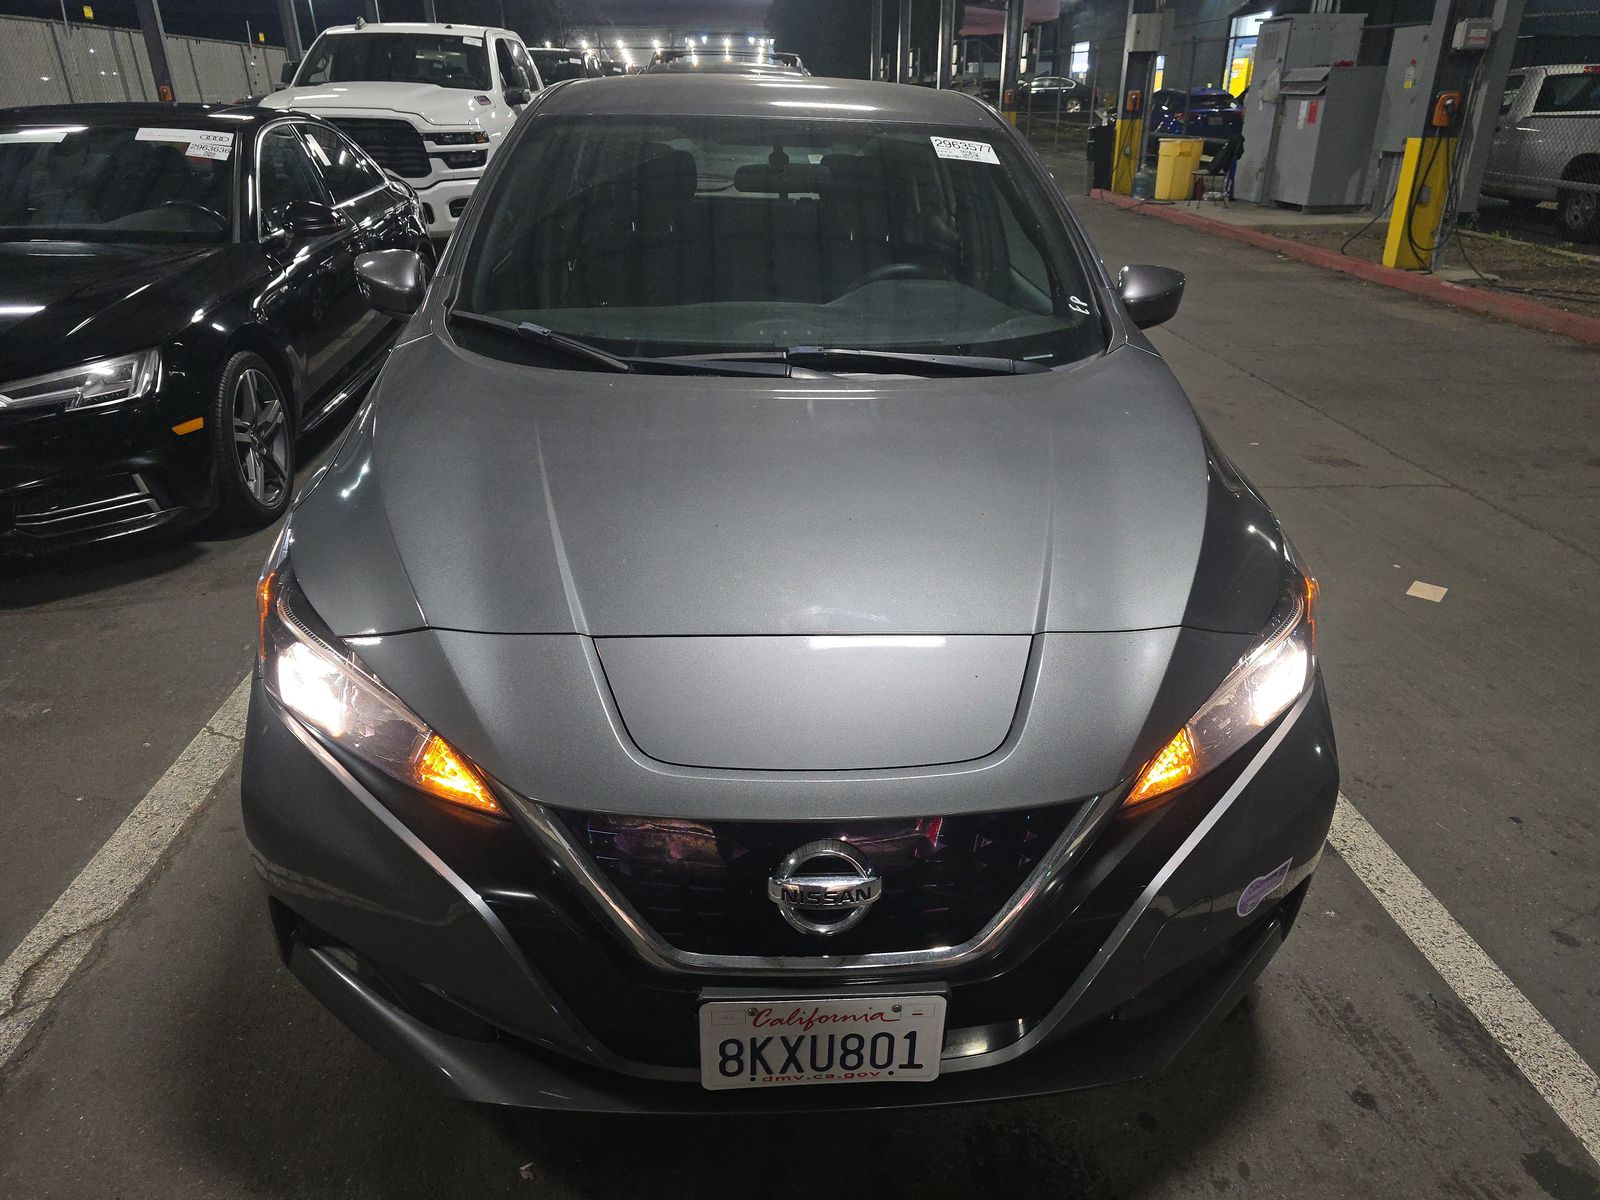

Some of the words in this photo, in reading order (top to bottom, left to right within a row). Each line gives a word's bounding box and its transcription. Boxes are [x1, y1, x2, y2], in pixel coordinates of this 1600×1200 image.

[934, 139, 991, 152] 2963577
[780, 887, 872, 903] NISSAN
[752, 1007, 901, 1031] California
[718, 1030, 924, 1077] 8KXU801
[762, 1071, 881, 1083] dmv.ca.gov
